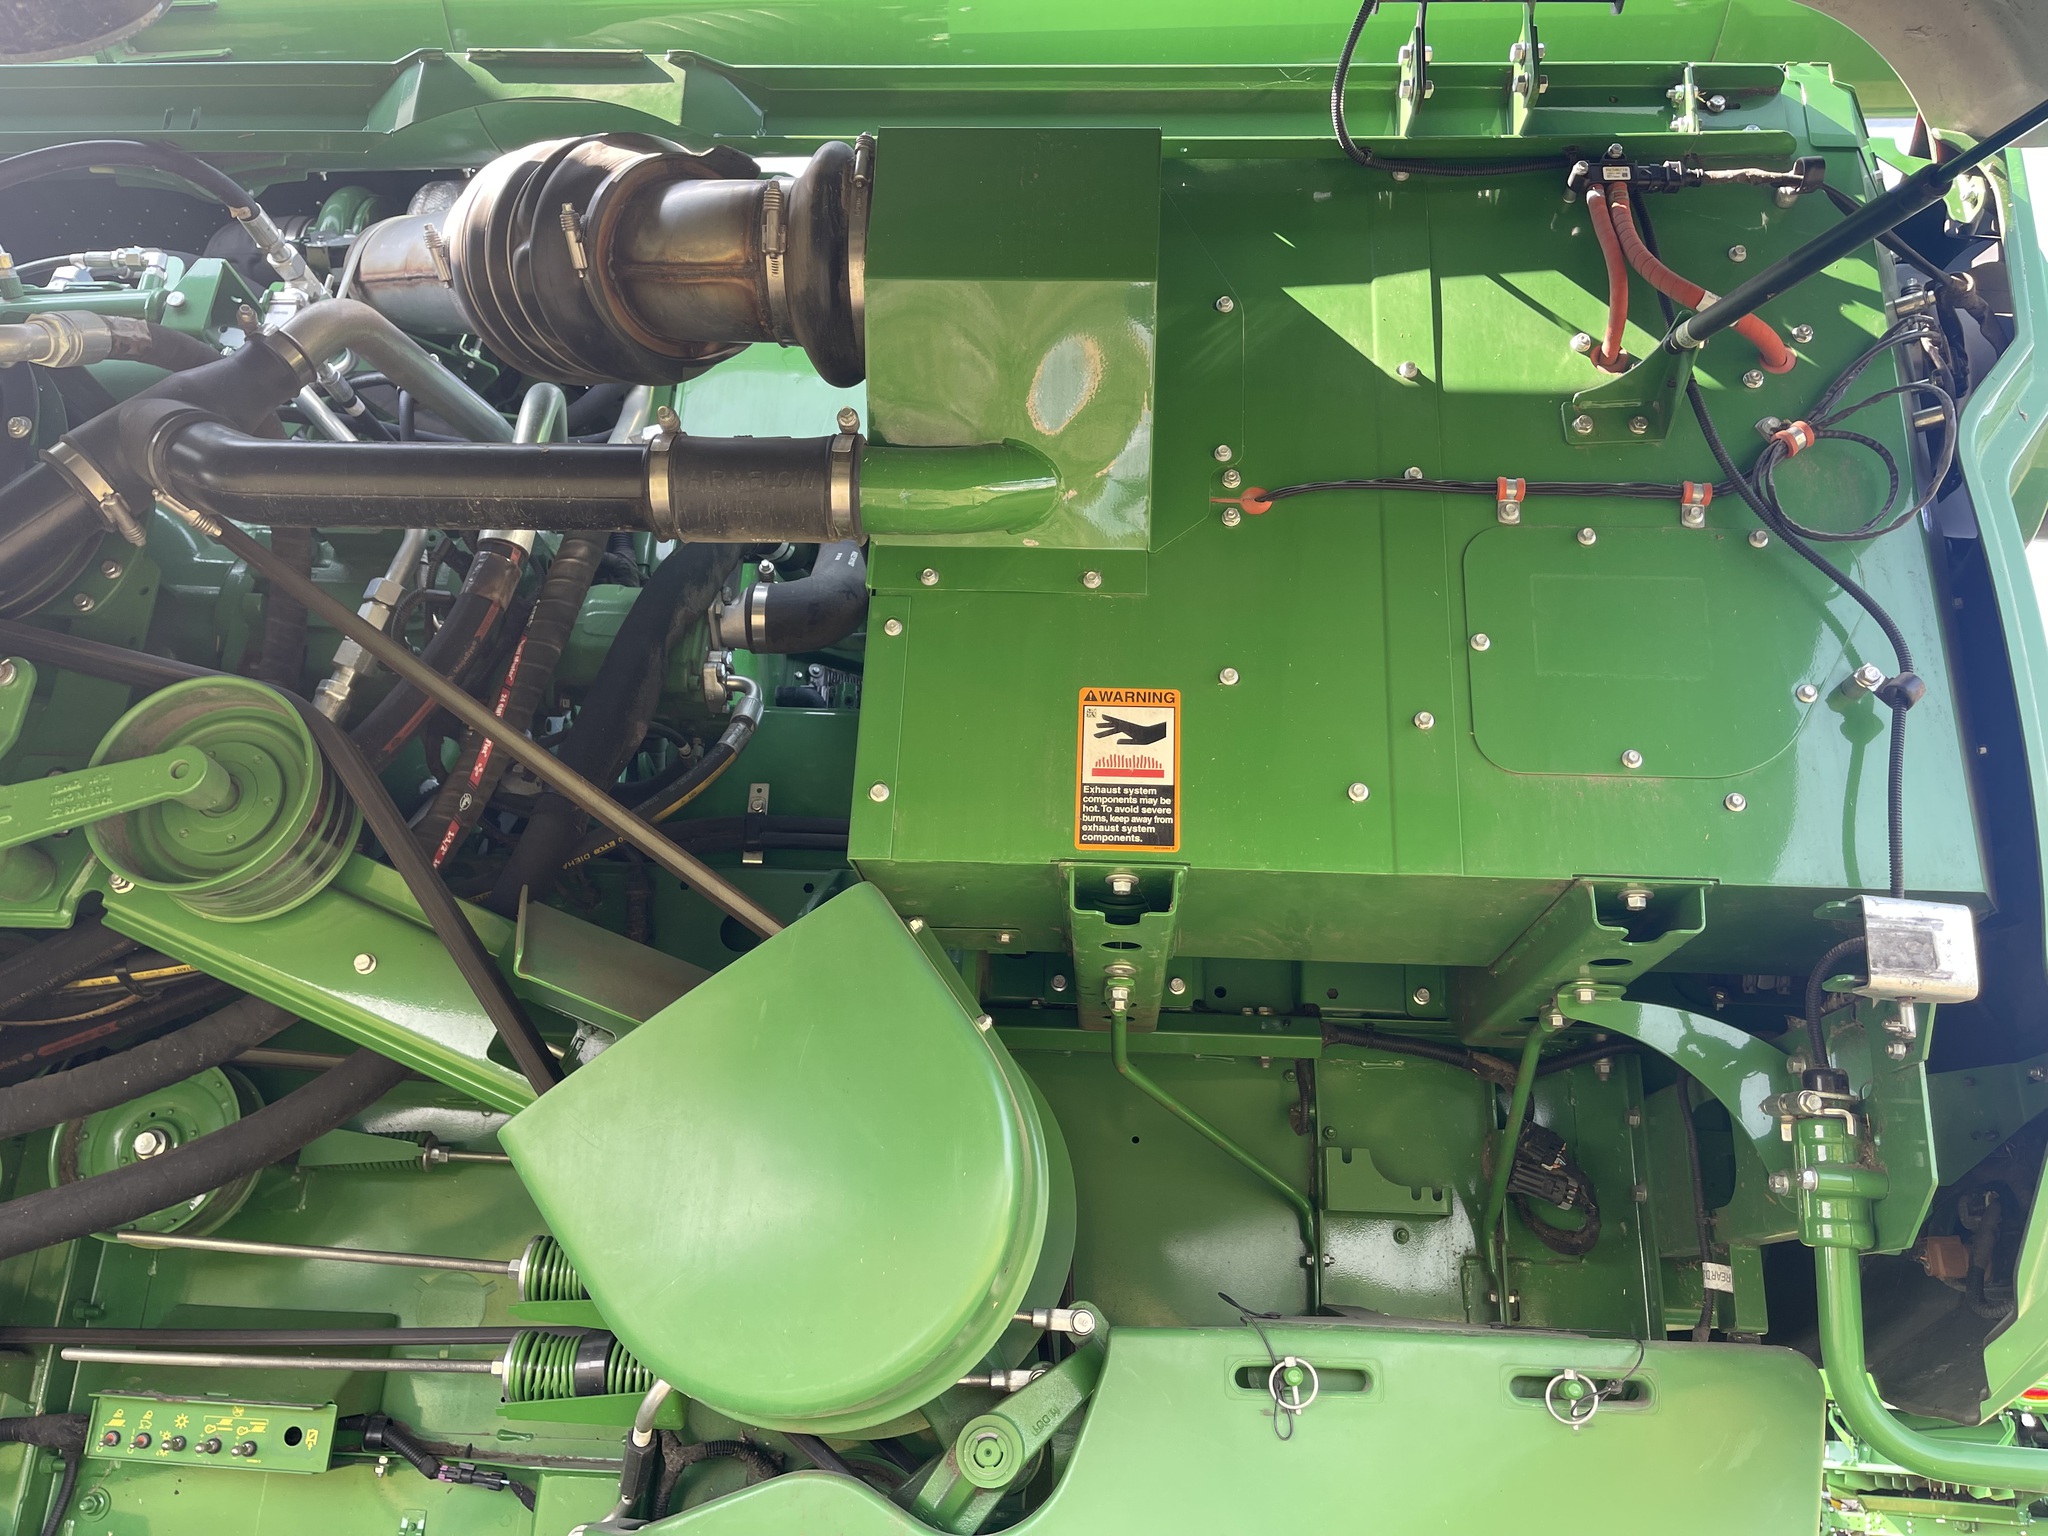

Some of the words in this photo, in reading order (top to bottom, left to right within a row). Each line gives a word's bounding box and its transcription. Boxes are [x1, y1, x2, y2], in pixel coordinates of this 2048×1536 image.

[1099, 690, 1176, 704] WARNING
[1083, 785, 1121, 794] Exhaust
[1123, 787, 1157, 796] system
[1082, 795, 1138, 805] components
[1139, 797, 1158, 806] may
[1159, 796, 1172, 805] be
[1082, 804, 1100, 813] hot.
[1101, 804, 1113, 813] To
[1114, 805, 1139, 814] avoid
[1141, 807, 1172, 815] severe
[1082, 814, 1109, 823] burns,
[1109, 814, 1130, 824] keep
[1130, 817, 1154, 825] away
[1153, 815, 1174, 824] from
[1081, 823, 1120, 832] exhaust
[1121, 825, 1156, 834] system
[1081, 833, 1143, 843] components.
